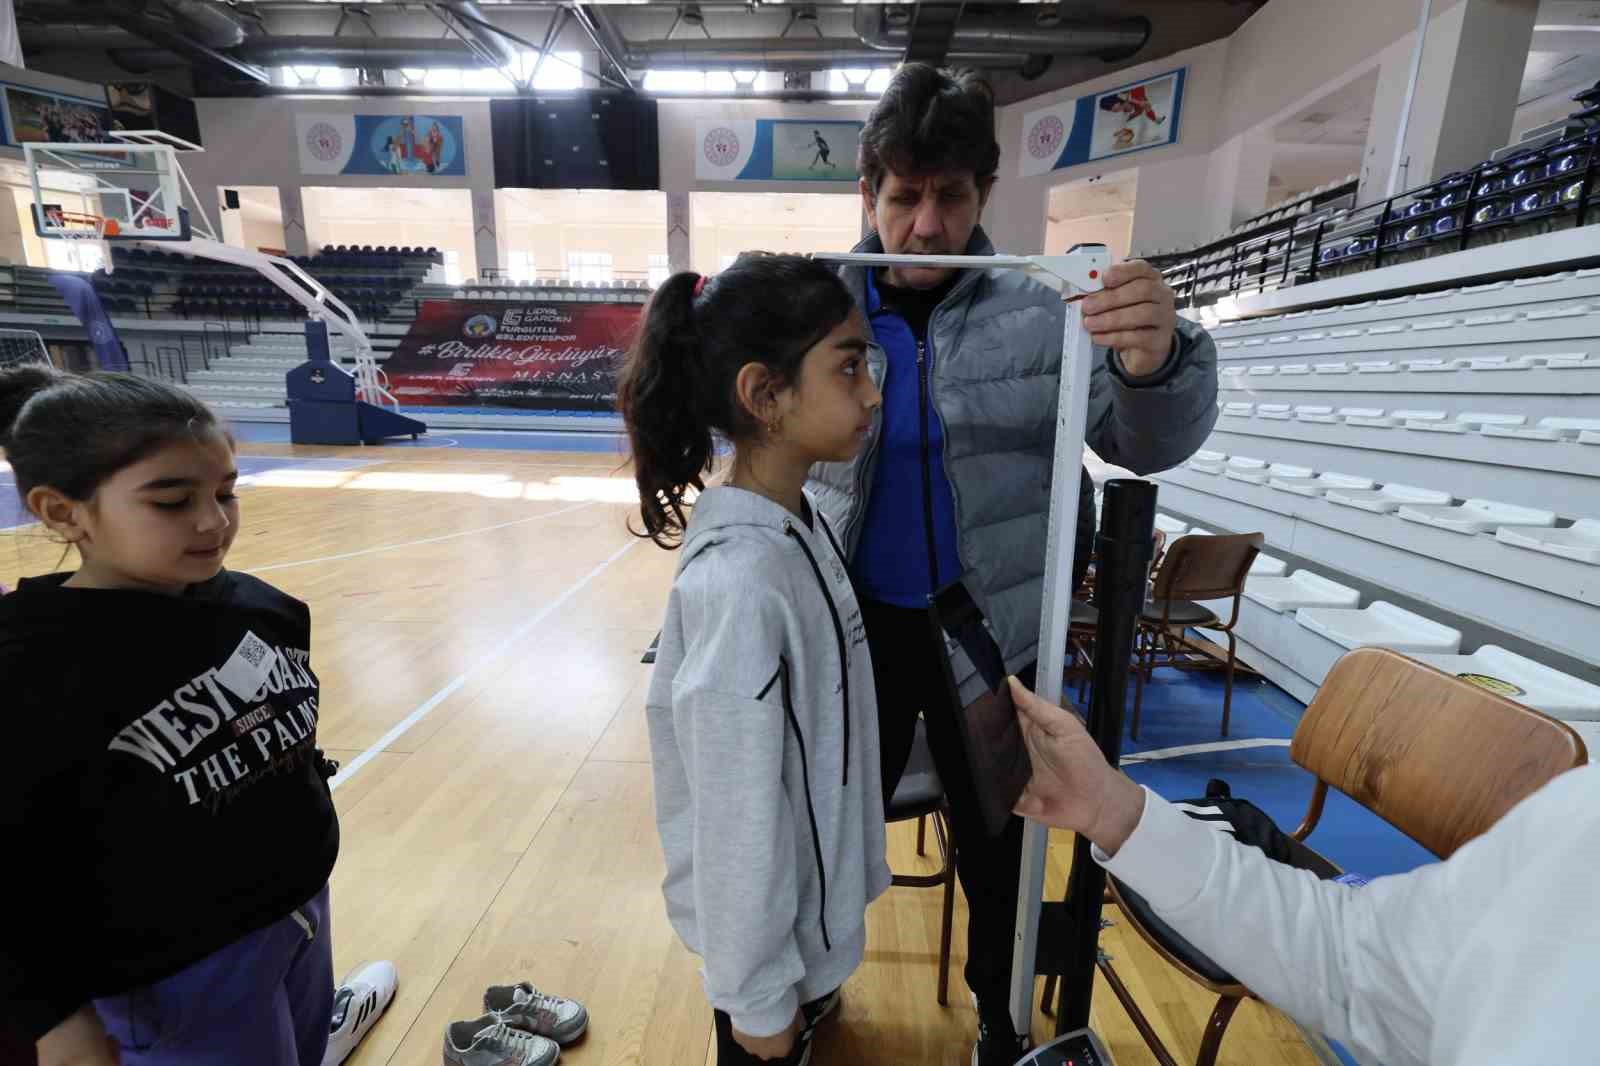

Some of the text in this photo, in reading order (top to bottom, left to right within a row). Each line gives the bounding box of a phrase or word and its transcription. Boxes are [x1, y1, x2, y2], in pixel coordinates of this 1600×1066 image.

[107, 667, 238, 774] WEST
[173, 743, 250, 805] THE
[250, 696, 318, 762] PALMS
[236, 704, 271, 735] SINCE
